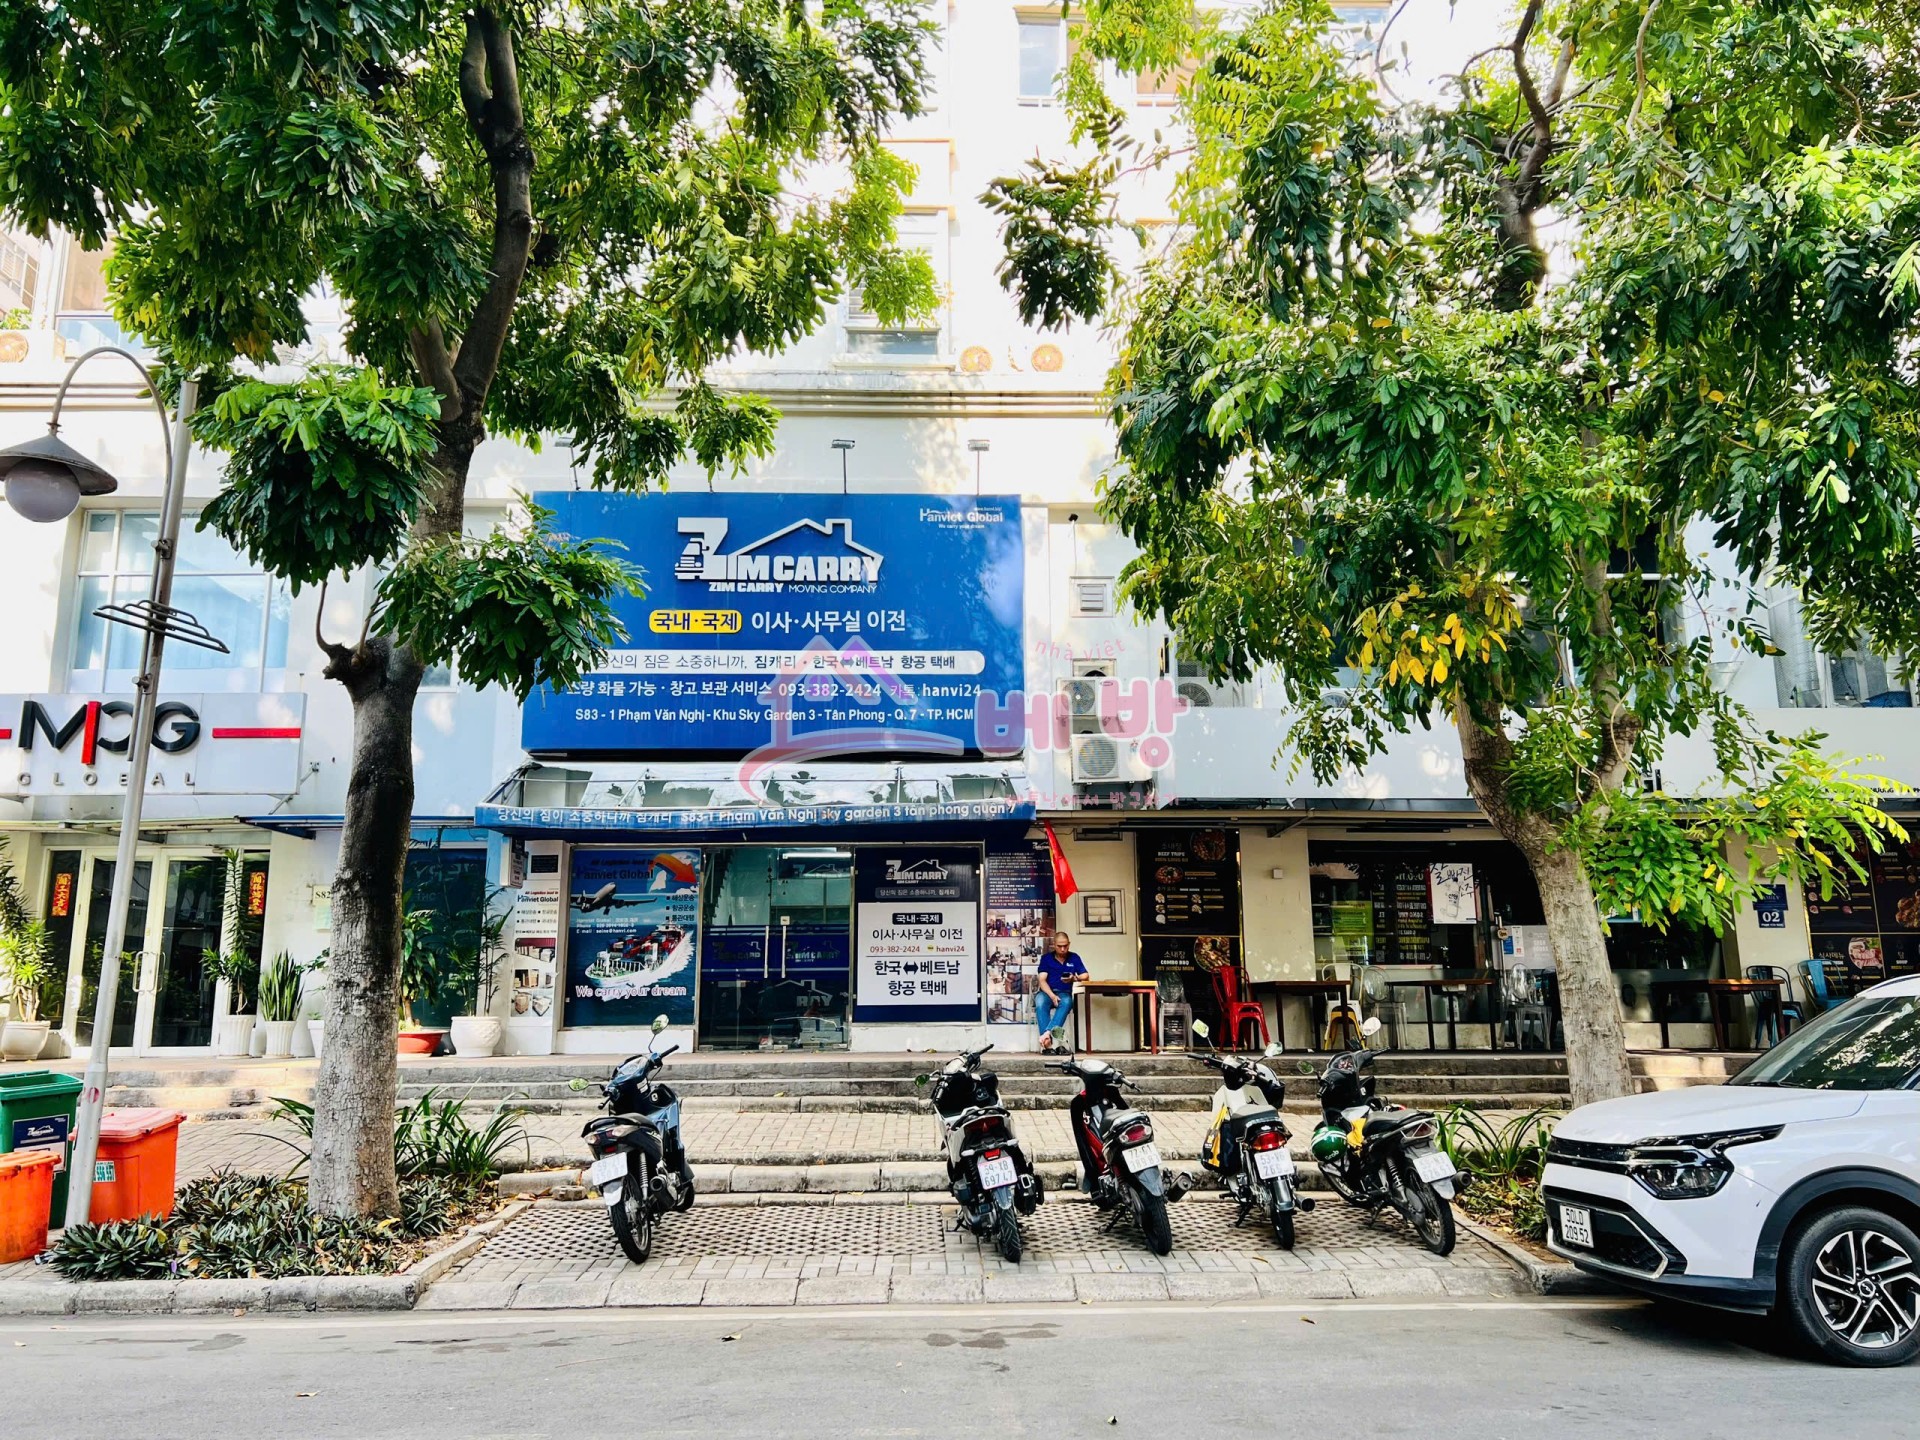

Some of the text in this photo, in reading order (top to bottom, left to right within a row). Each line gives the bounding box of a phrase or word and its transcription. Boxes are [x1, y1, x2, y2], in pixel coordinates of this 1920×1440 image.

[966, 512, 1003, 522] Global
[773, 555, 884, 582] CARRY
[708, 582, 877, 594] ZIM CARRY MOVING COMPANY
[866, 610, 906, 632] 이전
[643, 655, 670, 669] 짐은
[754, 655, 796, 669] 짐캐리
[812, 655, 839, 669] 한국
[855, 655, 894, 669] 베트남
[900, 656, 926, 669] 항공
[930, 656, 956, 669] 택배
[597, 681, 626, 697] 화물
[628, 681, 657, 697] 가능
[670, 681, 697, 697] 창고
[700, 681, 728, 697] 보관
[730, 681, 772, 697] 서비스
[778, 684, 881, 697] 093-382-2424
[575, 709, 598, 721] S83
[618, 709, 651, 724] Phạm
[654, 708, 676, 720] Văn
[679, 709, 705, 724] Nghị
[713, 709, 737, 720] Khu
[739, 709, 761, 724] Sky
[764, 709, 806, 721] Garden
[808, 709, 816, 721] 3
[824, 708, 846, 721] Tân
[849, 709, 885, 724] Phong
[894, 709, 907, 722] Q.
[910, 709, 918, 721] 7
[497, 807, 534, 822] 당신의
[539, 808, 563, 822] 짐이
[568, 809, 631, 823] 소중하니까
[787, 807, 817, 823] Nghị
[820, 809, 841, 823] sky
[844, 807, 890, 822] garden
[893, 806, 902, 817] 3
[928, 804, 970, 819] phong
[972, 803, 1005, 818] quận
[915, 871, 949, 880] CARRY
[1762, 911, 1781, 923] 02
[939, 928, 963, 940] 이전
[869, 945, 965, 953] 093-382-2424 hanvi24
[874, 960, 961, 976] 한국 베트남
[575, 985, 594, 998] We
[651, 985, 687, 997] dream
[888, 980, 947, 996] 항공 택배
[1565, 1224, 1590, 1244] 209.52
